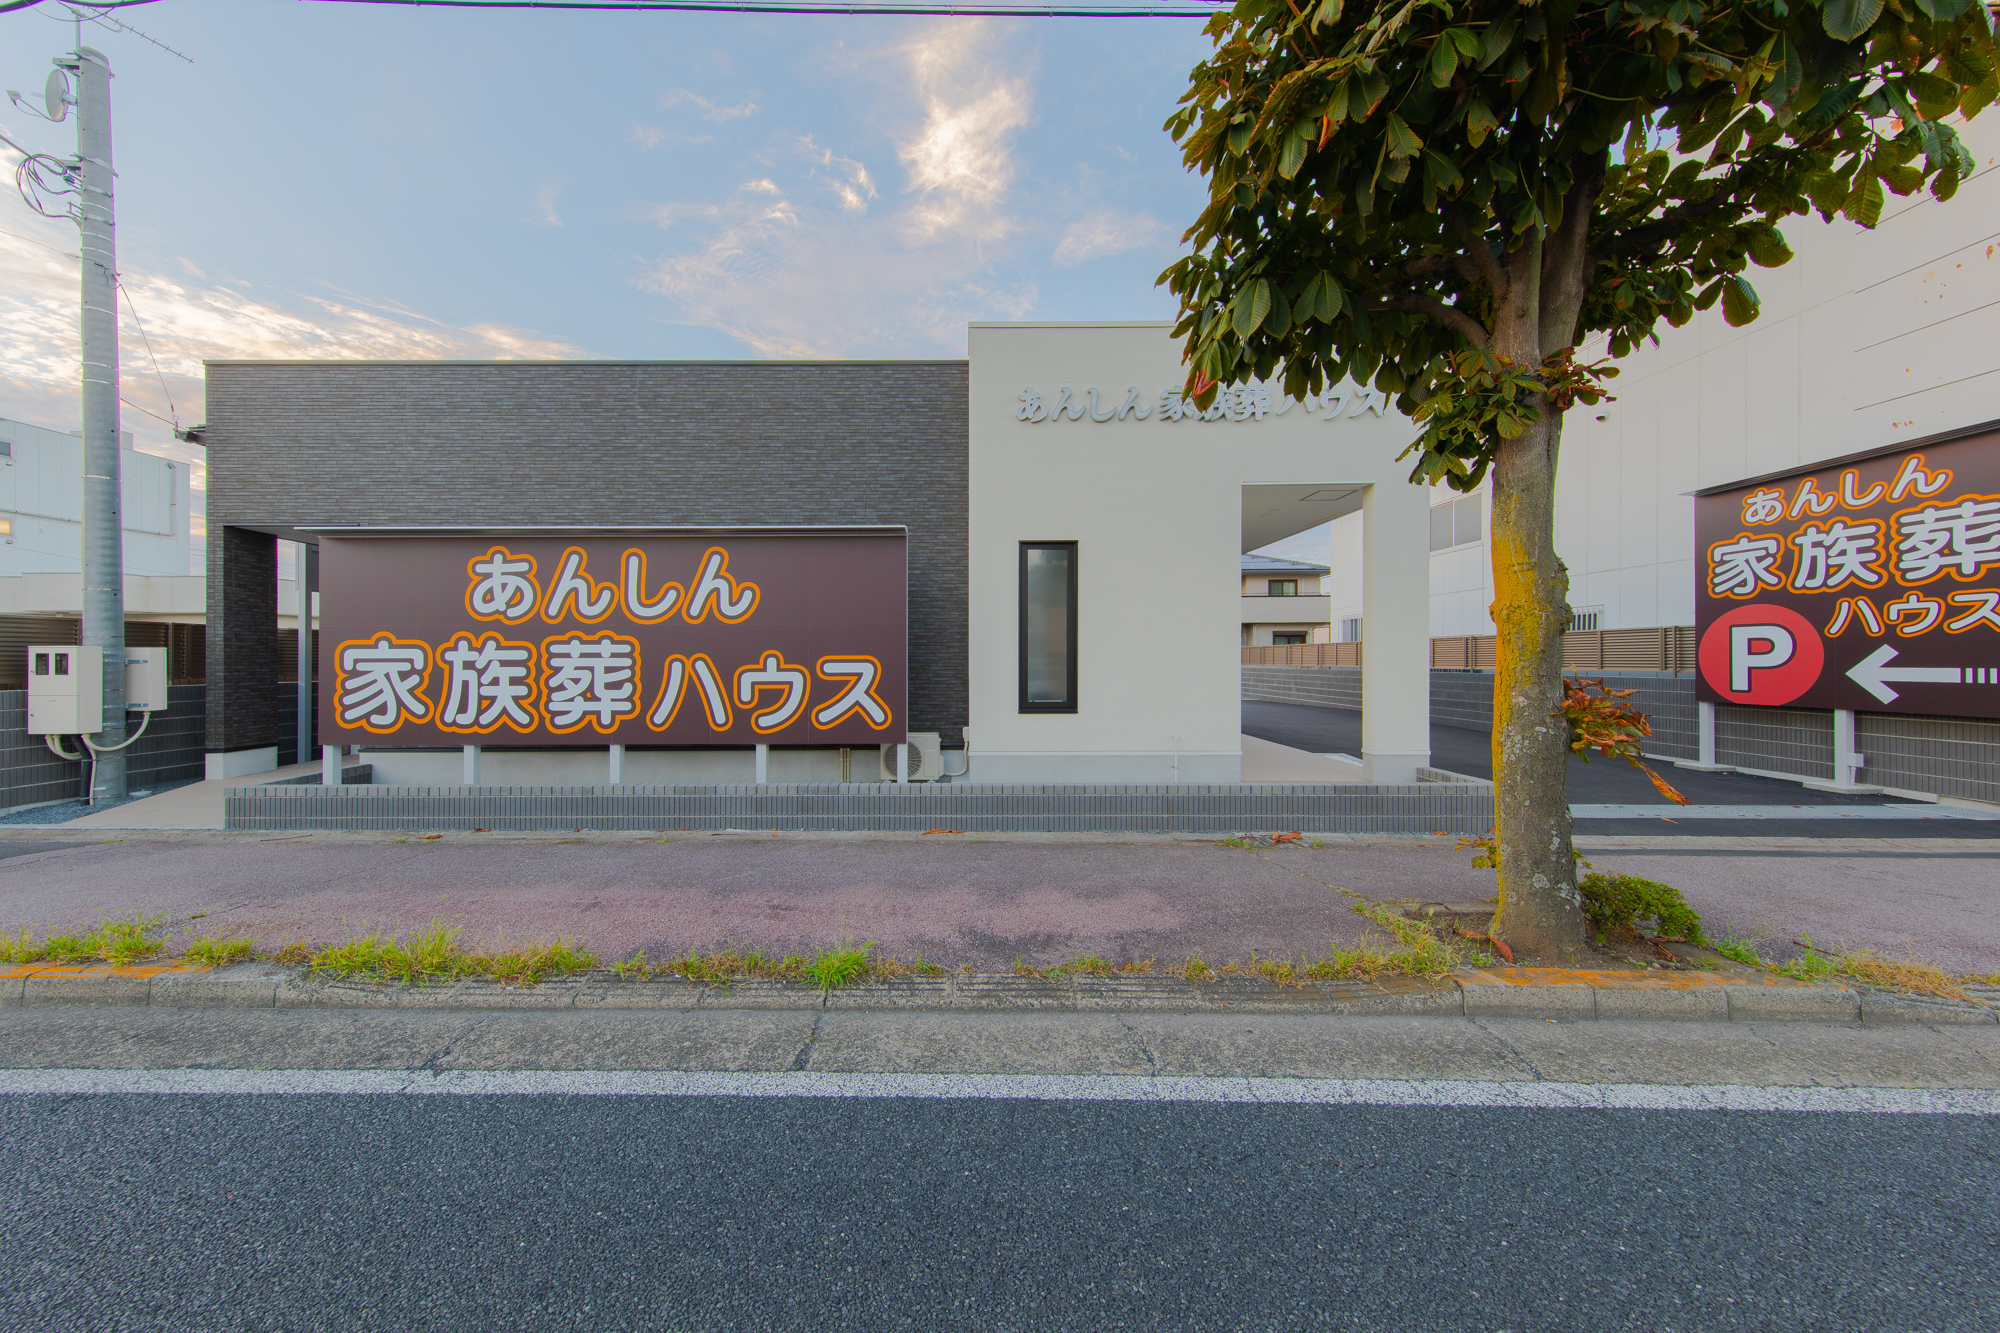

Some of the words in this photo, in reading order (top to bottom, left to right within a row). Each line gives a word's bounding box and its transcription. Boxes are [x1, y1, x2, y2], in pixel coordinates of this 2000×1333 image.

[1742, 454, 1954, 526] あんしん
[1707, 494, 2000, 599] 家族葬
[465, 546, 760, 624] あんしん
[1824, 589, 2000, 638] ハウス
[333, 630, 891, 734] 家族葬ハウス
[1729, 623, 1798, 693] P
